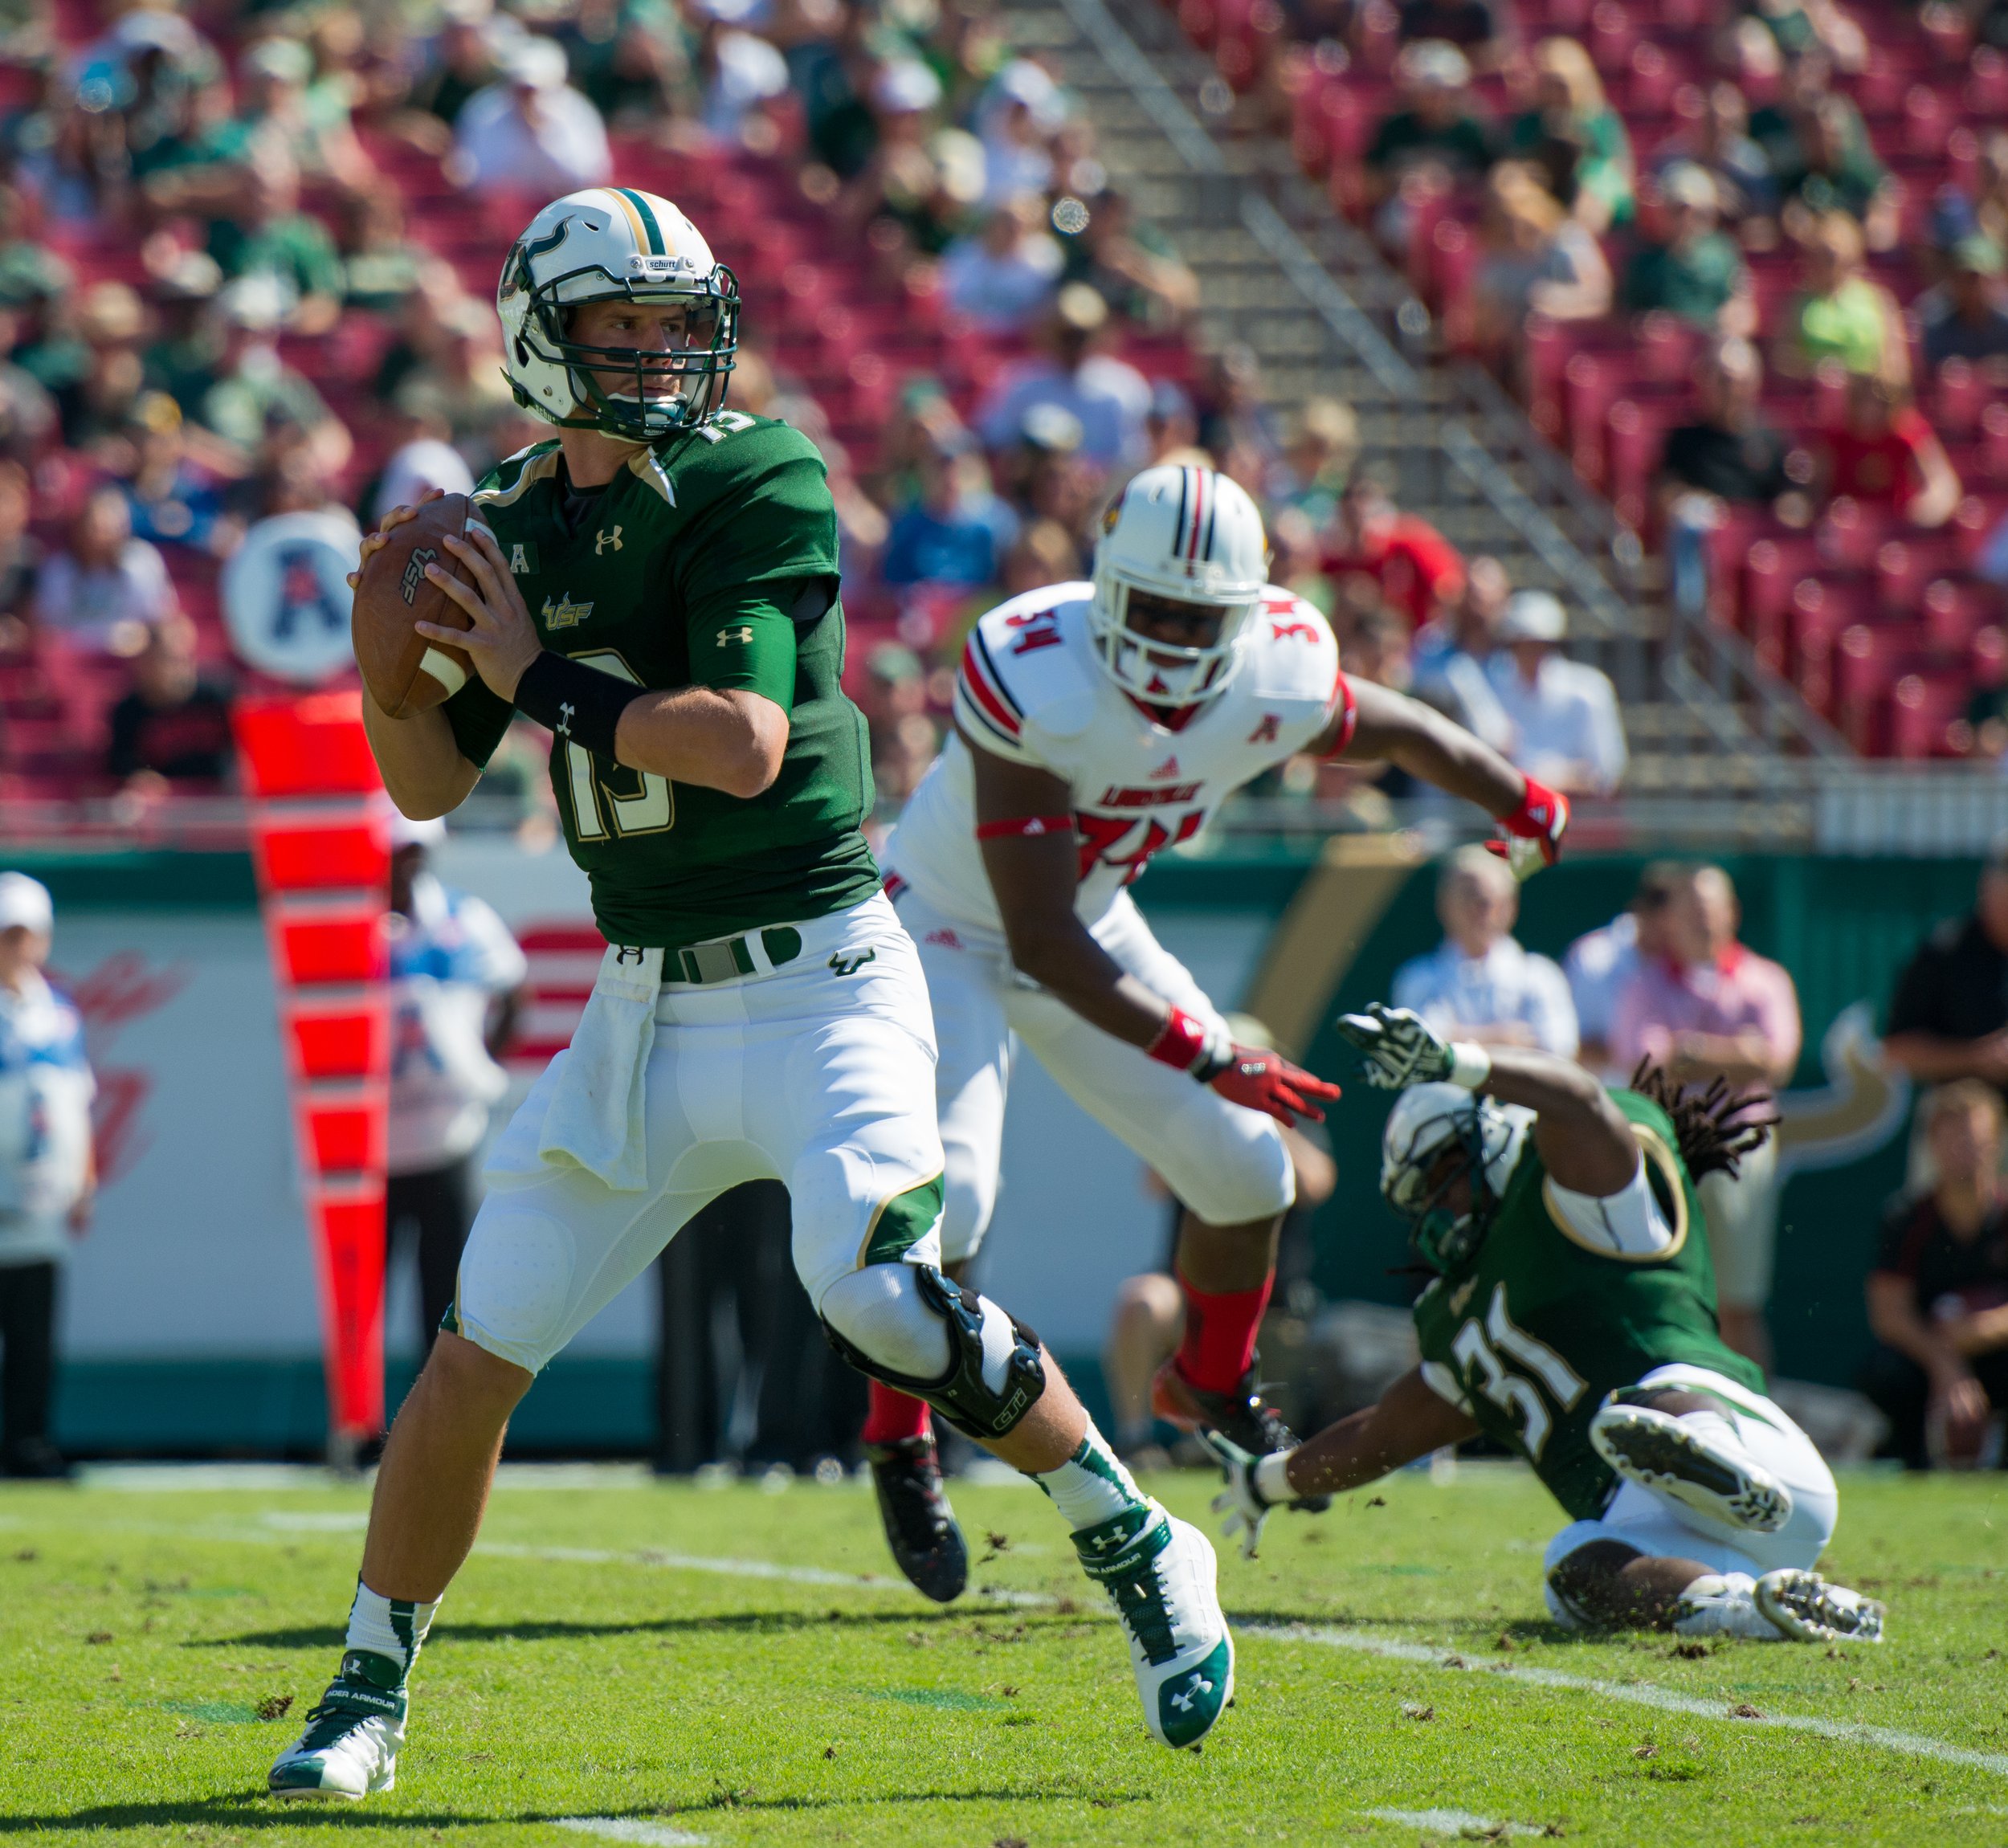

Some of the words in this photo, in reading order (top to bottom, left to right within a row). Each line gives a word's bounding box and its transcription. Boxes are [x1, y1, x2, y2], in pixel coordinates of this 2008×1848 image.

[649, 259, 676, 269] schutt
[511, 544, 530, 574] A
[541, 590, 594, 631] USF
[1451, 1280, 1590, 1465] 31
[1100, 1552, 1141, 1574] ARMOUR
[351, 1692, 395, 1711] ARMOUR
